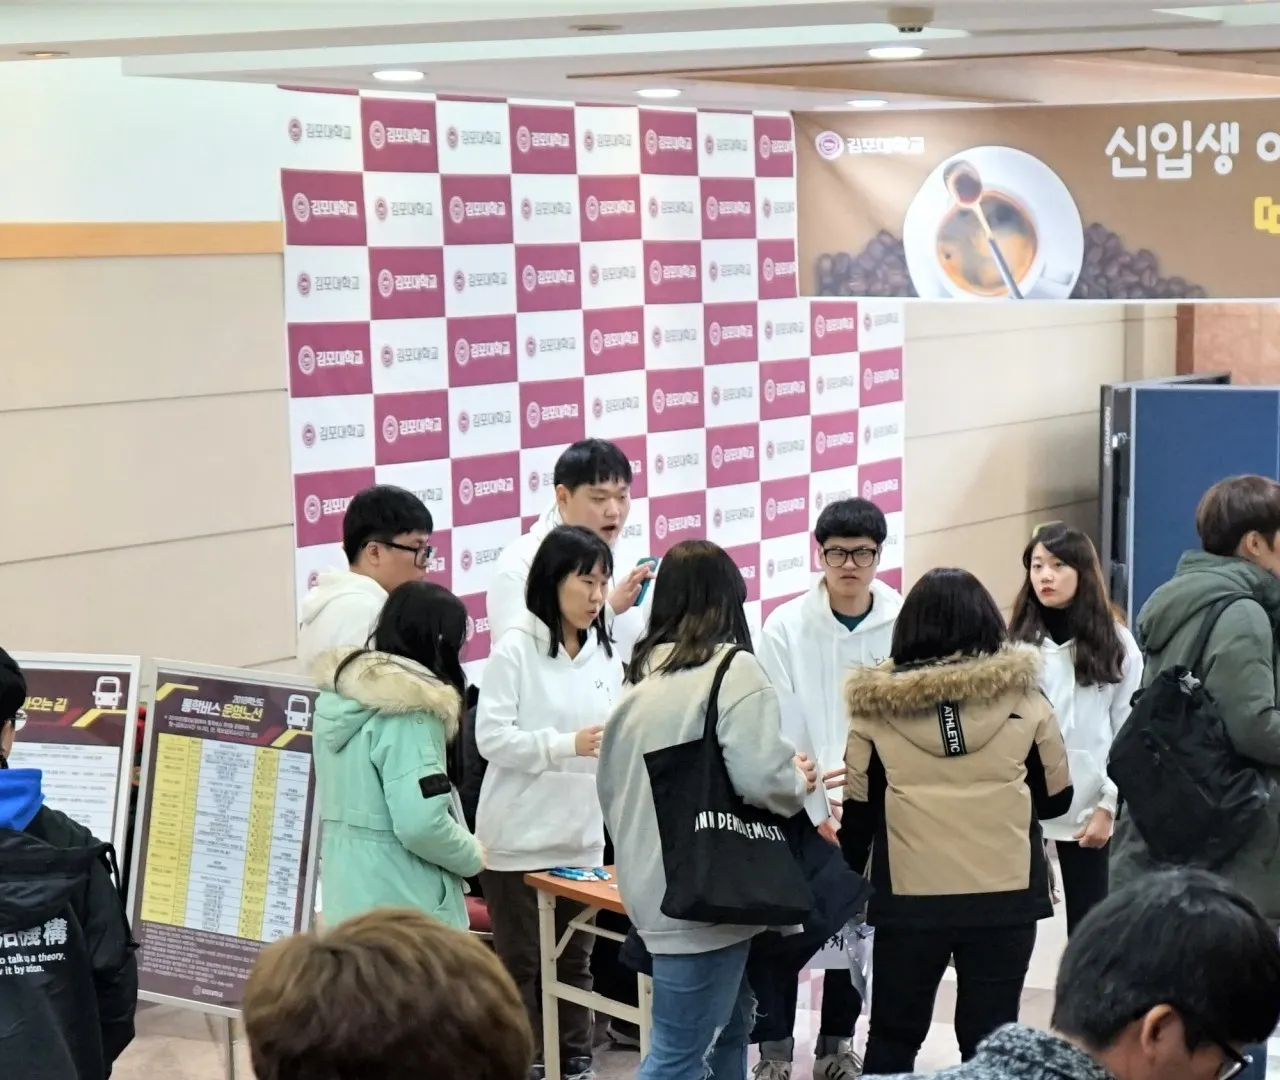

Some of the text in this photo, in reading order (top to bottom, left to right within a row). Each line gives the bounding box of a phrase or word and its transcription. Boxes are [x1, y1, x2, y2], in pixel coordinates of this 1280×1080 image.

[306, 122, 352, 140] 김포대학교
[385, 127, 431, 145] 김포대학교
[461, 130, 502, 146] 김포대학교
[530, 132, 570, 148] 김포대학교
[1105, 120, 1240, 179] 신입생
[310, 200, 358, 217] 김포대학교
[391, 201, 433, 217] 김포대학교
[465, 200, 506, 217] 김포대학교
[535, 201, 571, 216] 김포대학교
[314, 276, 360, 291] 김포대학교
[394, 274, 438, 291] 김포대학교
[468, 272, 508, 287] 김포대학교
[537, 269, 575, 284] 김포대학교
[471, 341, 510, 358] 김포대학교
[539, 337, 576, 352] 김포대학교
[316, 350, 364, 368] 김포대학교
[396, 346, 439, 363] 김포대학교
[472, 410, 511, 428] 김포대학교
[542, 404, 578, 420] 김포대학교
[319, 424, 365, 441] 김포대학교
[399, 417, 442, 435] 김포대학교
[474, 478, 514, 496] 김포대학교
[23, 696, 53, 711] 오는
[181, 698, 264, 722] 통학버스 운영노선
[944, 705, 960, 753] ATHLETIC
[7, 953, 24, 964] talk
[38, 952, 66, 962] theory.
[5, 966, 13, 975] it
[14, 964, 25, 975] by
